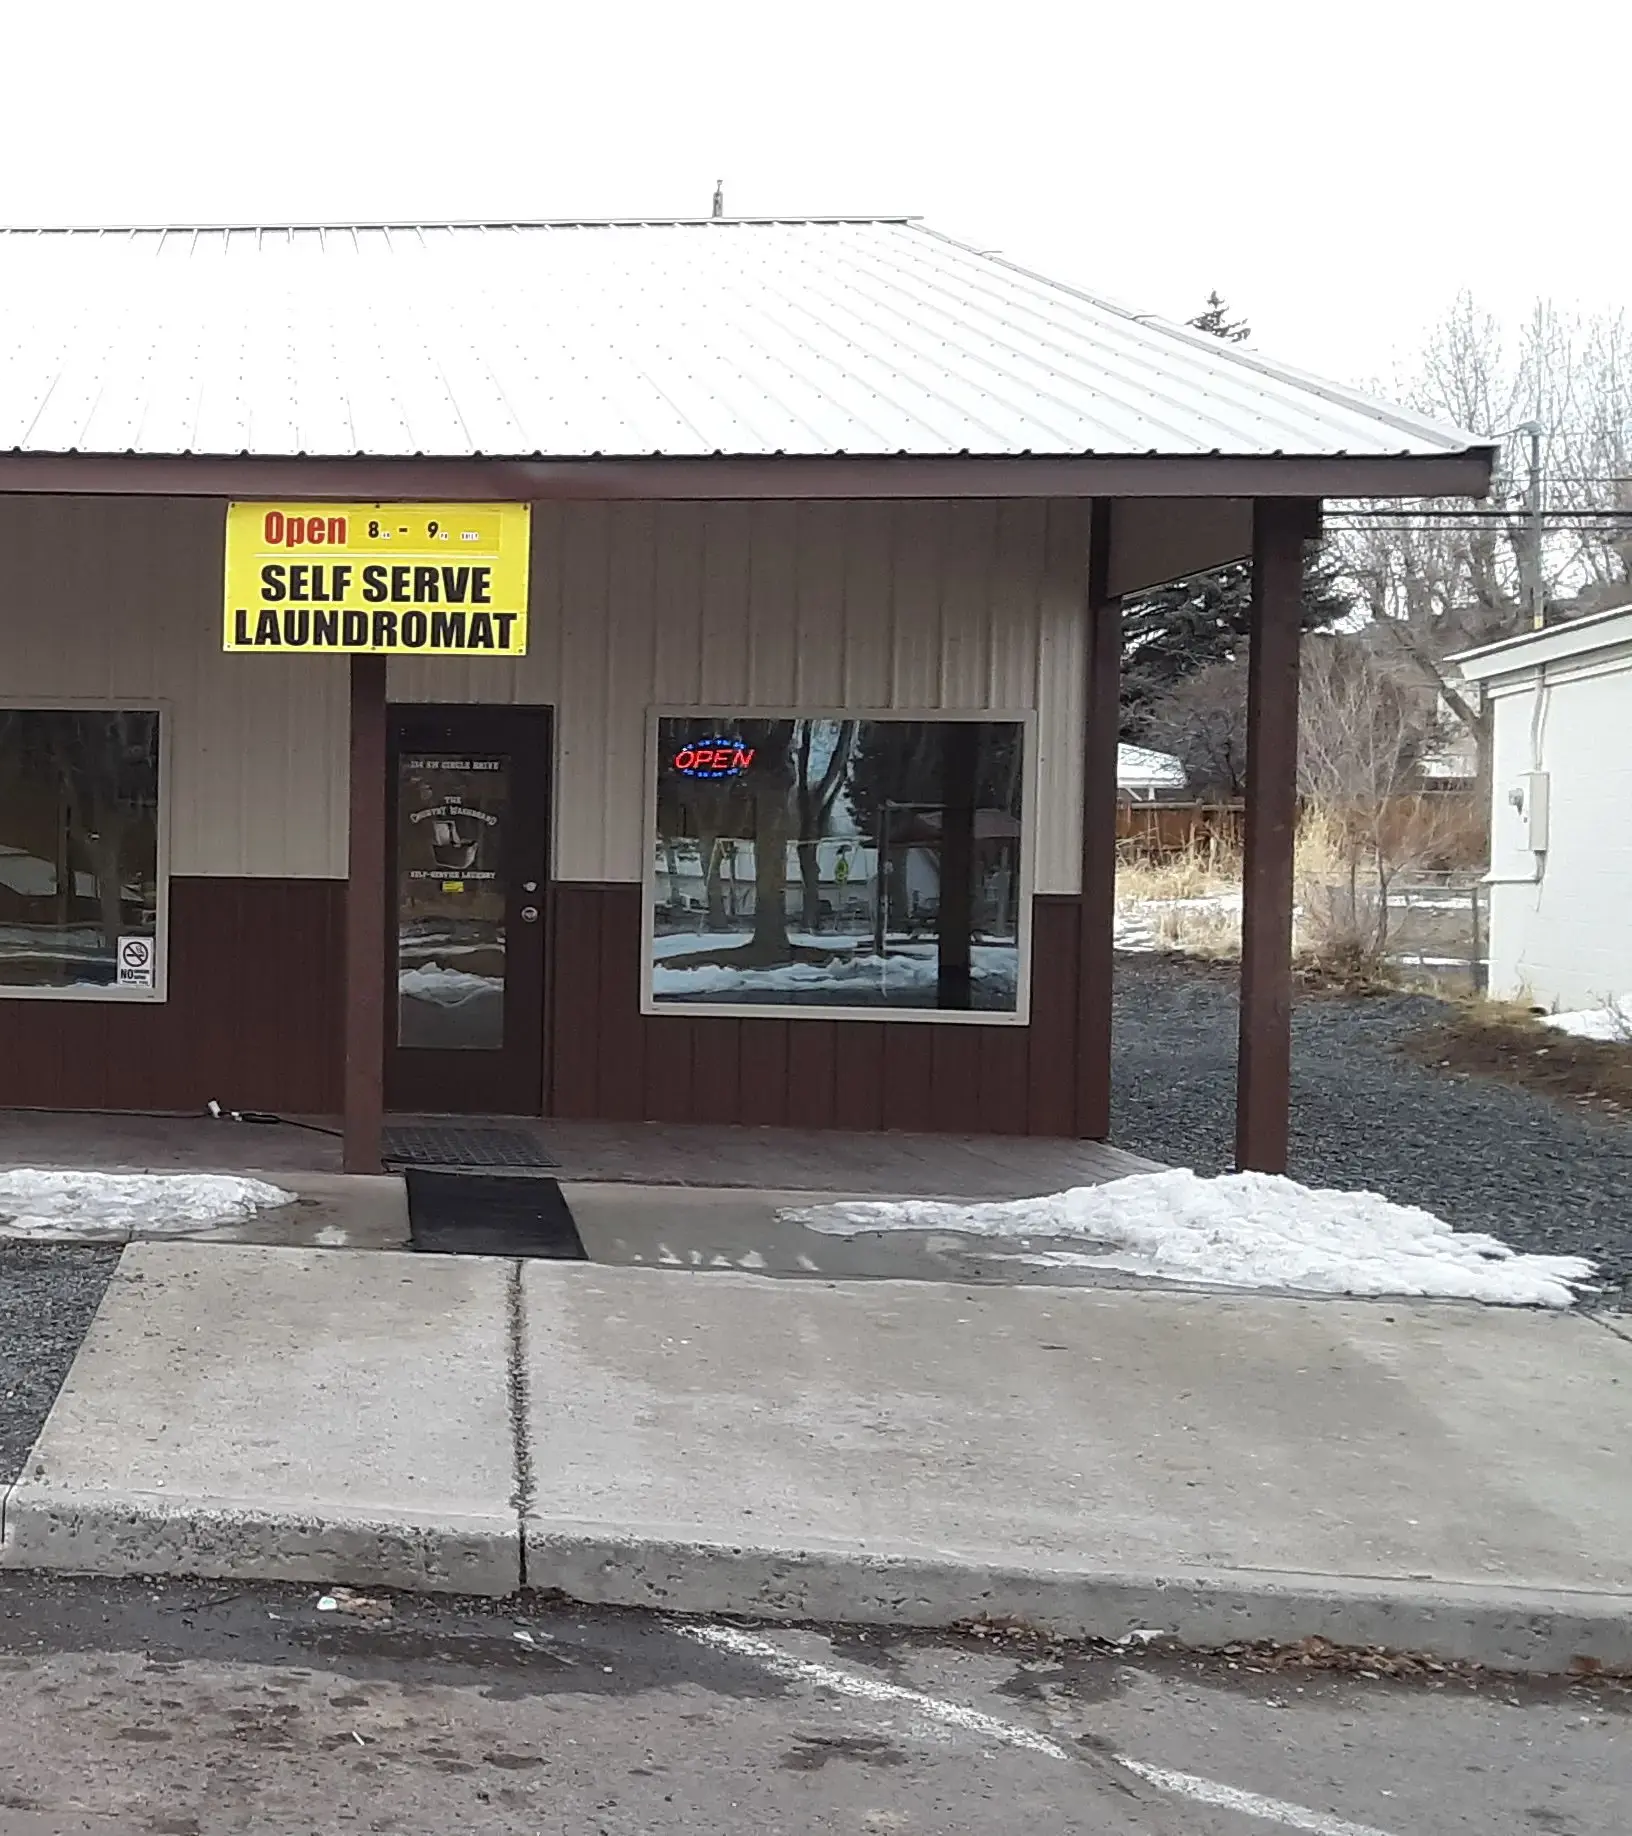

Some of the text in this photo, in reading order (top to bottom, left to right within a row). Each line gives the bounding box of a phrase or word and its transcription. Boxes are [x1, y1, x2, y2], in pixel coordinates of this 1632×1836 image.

[264, 511, 346, 547] Open
[368, 521, 379, 539] 8
[428, 521, 439, 539] 9
[261, 565, 492, 604] SELF SERVE
[235, 609, 518, 649] LAUNDROMAT
[441, 761, 471, 770] CIRCLE
[472, 761, 499, 770] DRIVE
[675, 749, 755, 769] OPEN
[443, 796, 462, 804] THE
[121, 969, 134, 979] NO
